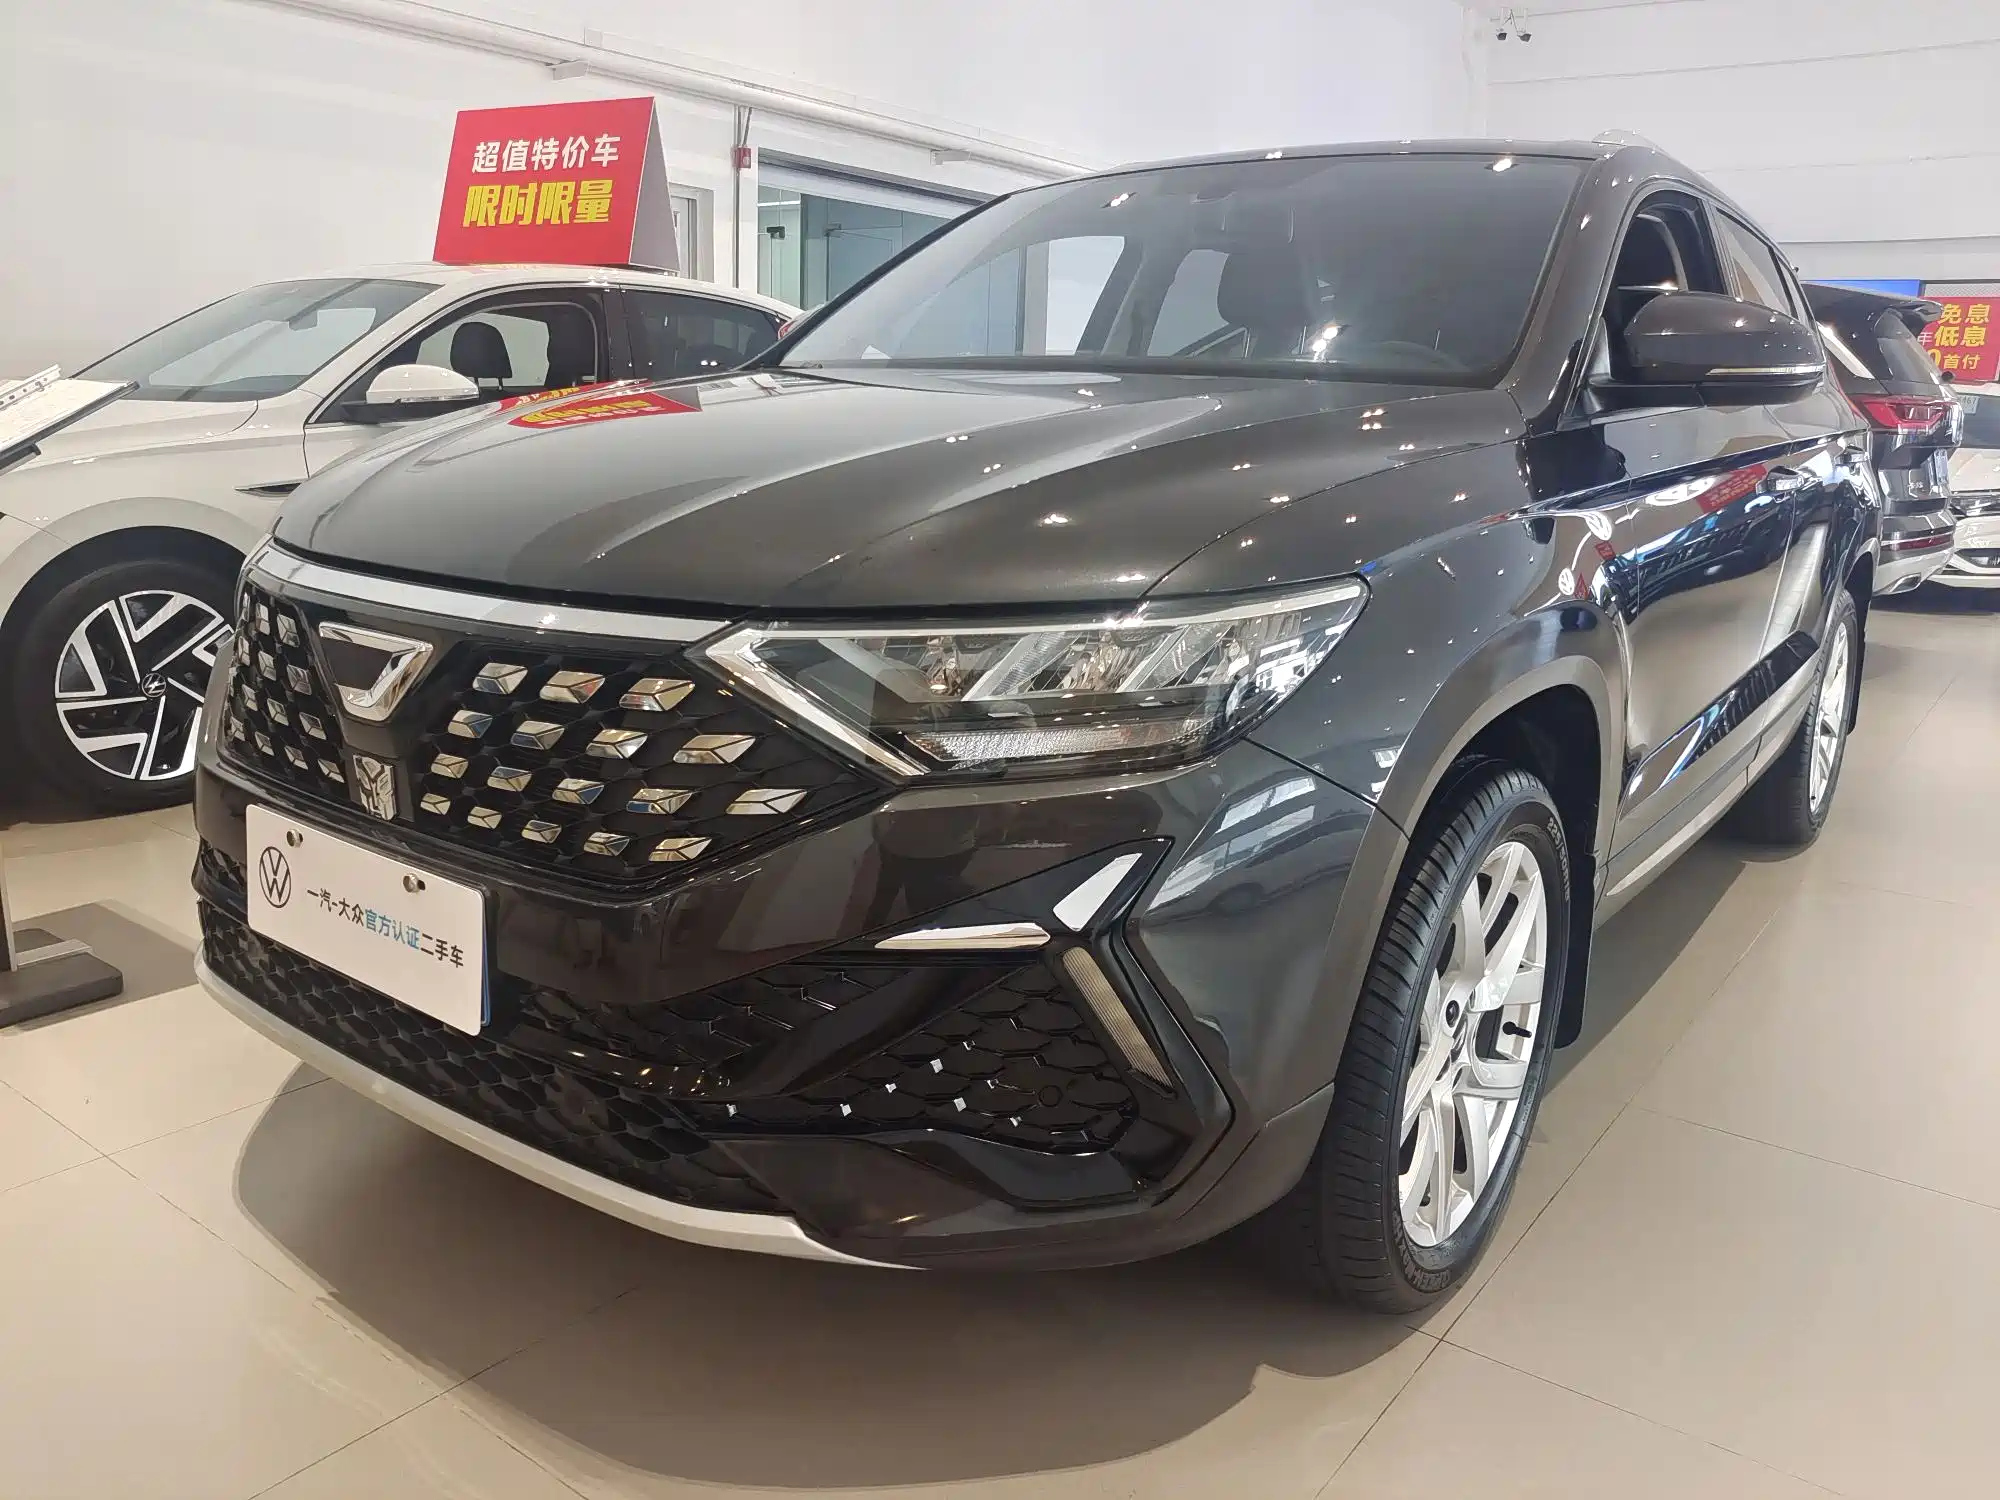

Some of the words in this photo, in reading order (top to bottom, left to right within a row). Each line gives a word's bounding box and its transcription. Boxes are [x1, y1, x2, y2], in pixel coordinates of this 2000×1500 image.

[472, 133, 621, 174] 超值特价车
[462, 179, 613, 228] 限时限量
[1938, 303, 1991, 324] 免息
[1934, 325, 1987, 347] 低息
